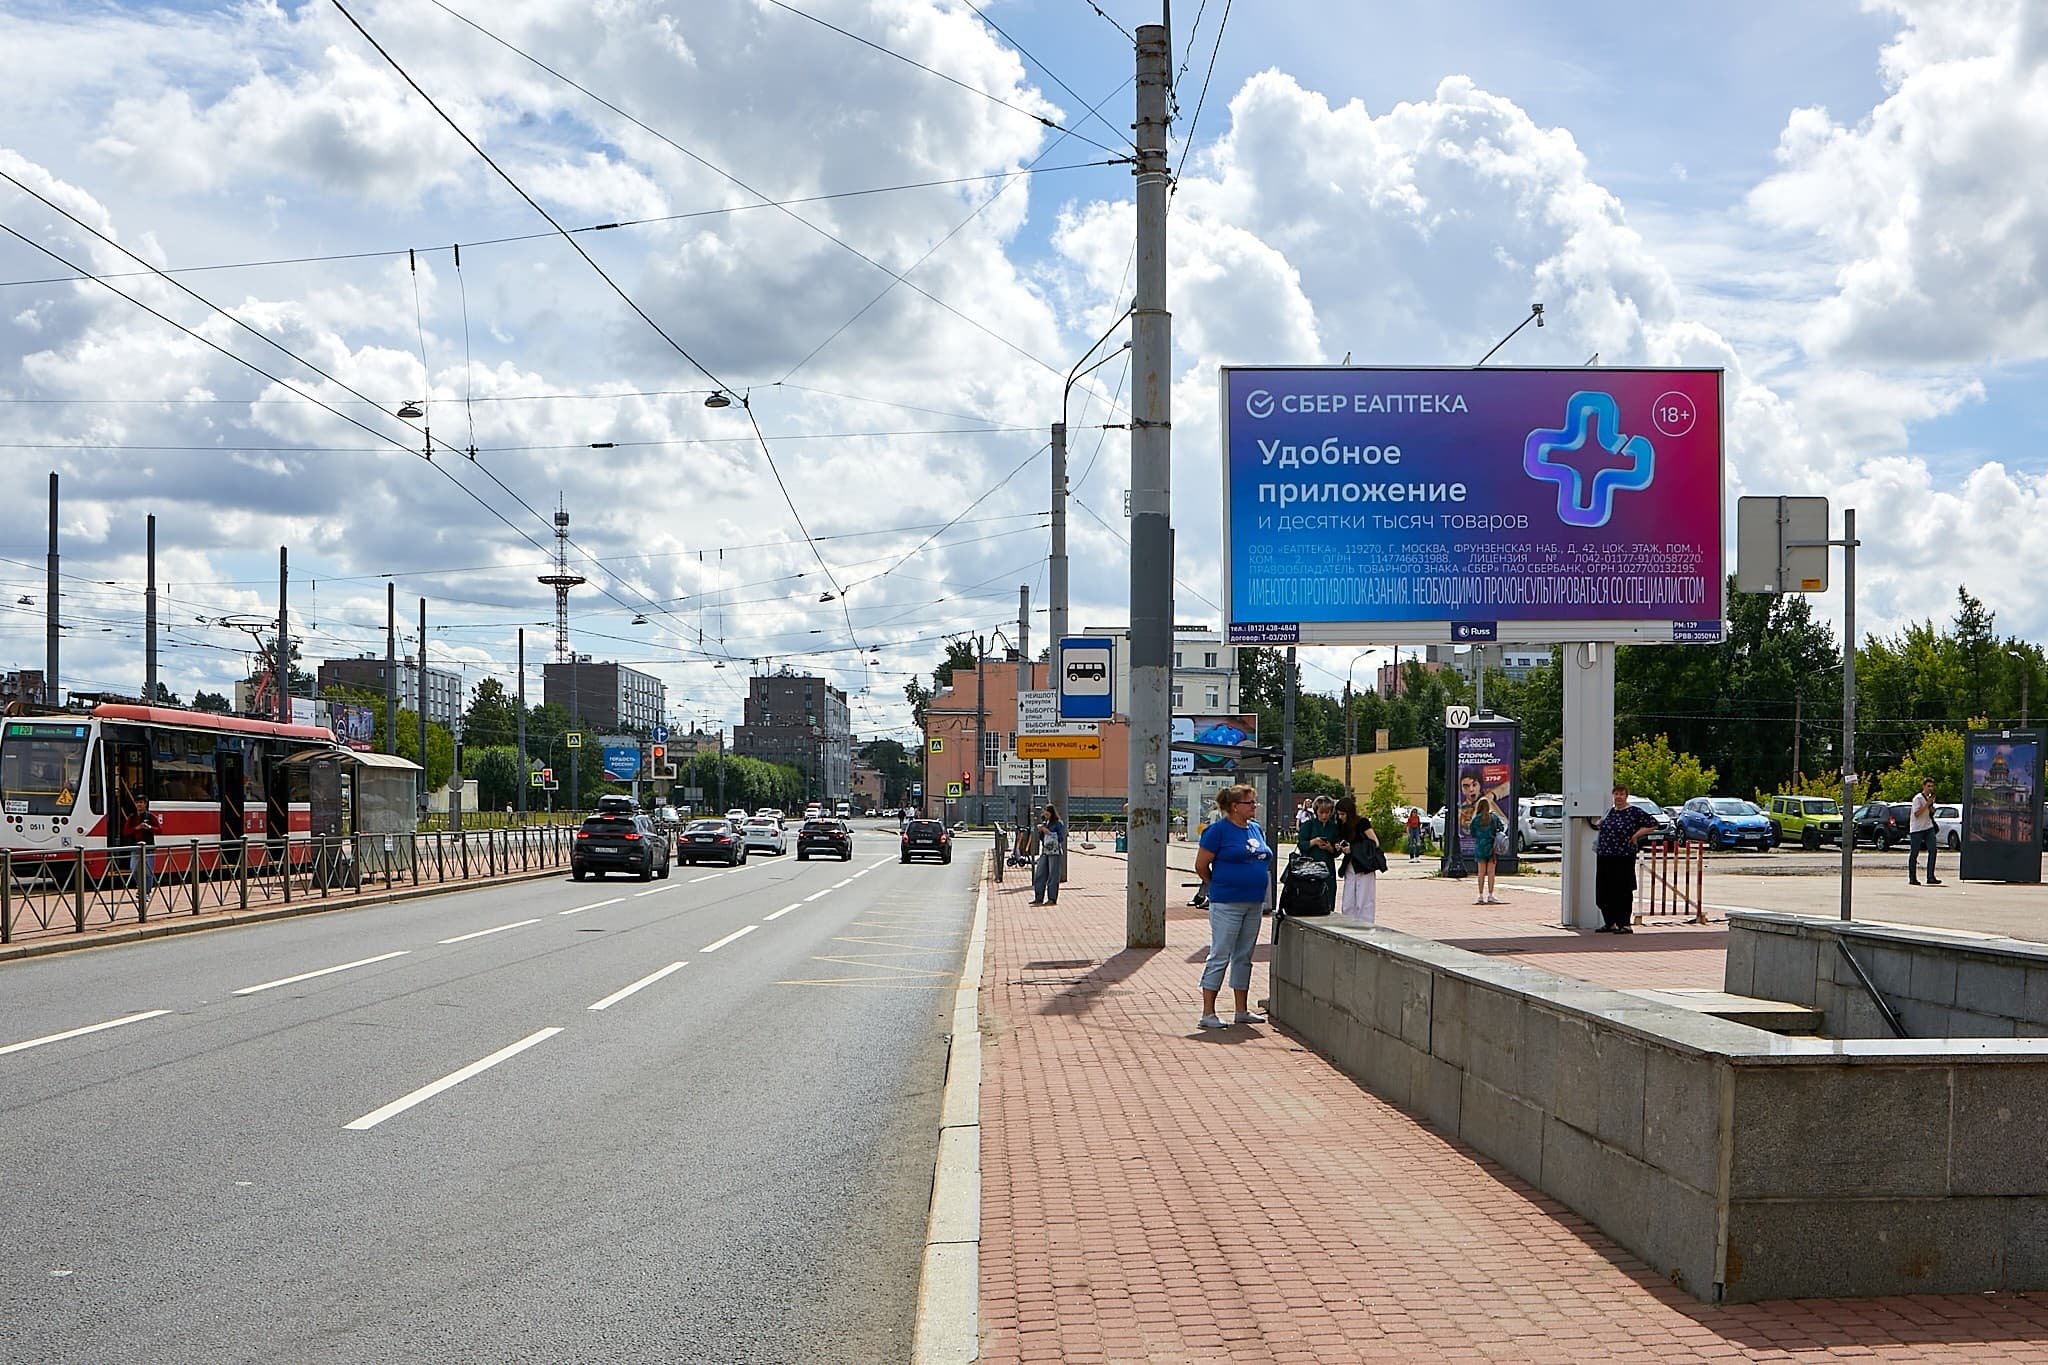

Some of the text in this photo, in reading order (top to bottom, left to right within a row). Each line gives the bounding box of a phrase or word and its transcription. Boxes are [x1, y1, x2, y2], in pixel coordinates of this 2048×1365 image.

[1281, 394, 1469, 414] СБЕР ЕАПТЕКА
[1660, 407, 1690, 423] 18+
[1257, 437, 1401, 469] Удобное
[1258, 481, 1468, 509] приложение
[1258, 512, 1529, 533] и десятки тысяч товаров
[1248, 544, 1274, 554] ООО
[1345, 544, 1385, 555] 119270,
[1388, 544, 1398, 553] Г.
[1401, 544, 1450, 554] МОСКВА,
[1453, 543, 1532, 553] ФРУНЗЕНСКАЯ
[1536, 543, 1564, 554] НАБ.,
[1567, 543, 1578, 554] Д.
[1582, 543, 1599, 554] 42,
[1602, 543, 1628, 554] ЦОК.
[1666, 543, 1694, 553] ПОМ.
[1322, 554, 1351, 564] ОГРН
[1371, 554, 1452, 565] 1147746631988,
[1469, 553, 1528, 564] ЛИЦЕНЗИЯ
[1545, 553, 1558, 563] №
[1249, 563, 1698, 575] ПРАВООБЛАДАТЕЛЬ ТОВАРНОГО ЗНАКА «СБЕР» ПАО СБЕРБАНК, ОГРН 1027700132195.
[1249, 576, 1705, 610] ИМЕЮТСЯ ПРОТИВОПОКАЗАНИЯ. НЕОБХОДИМО ПРОКОНСУЛЬТИРОВАТЬСЯ СО СПЕЦИАЛИСТОМ
[1471, 627, 1491, 635] Russ
[30, 823, 45, 831] 0511
